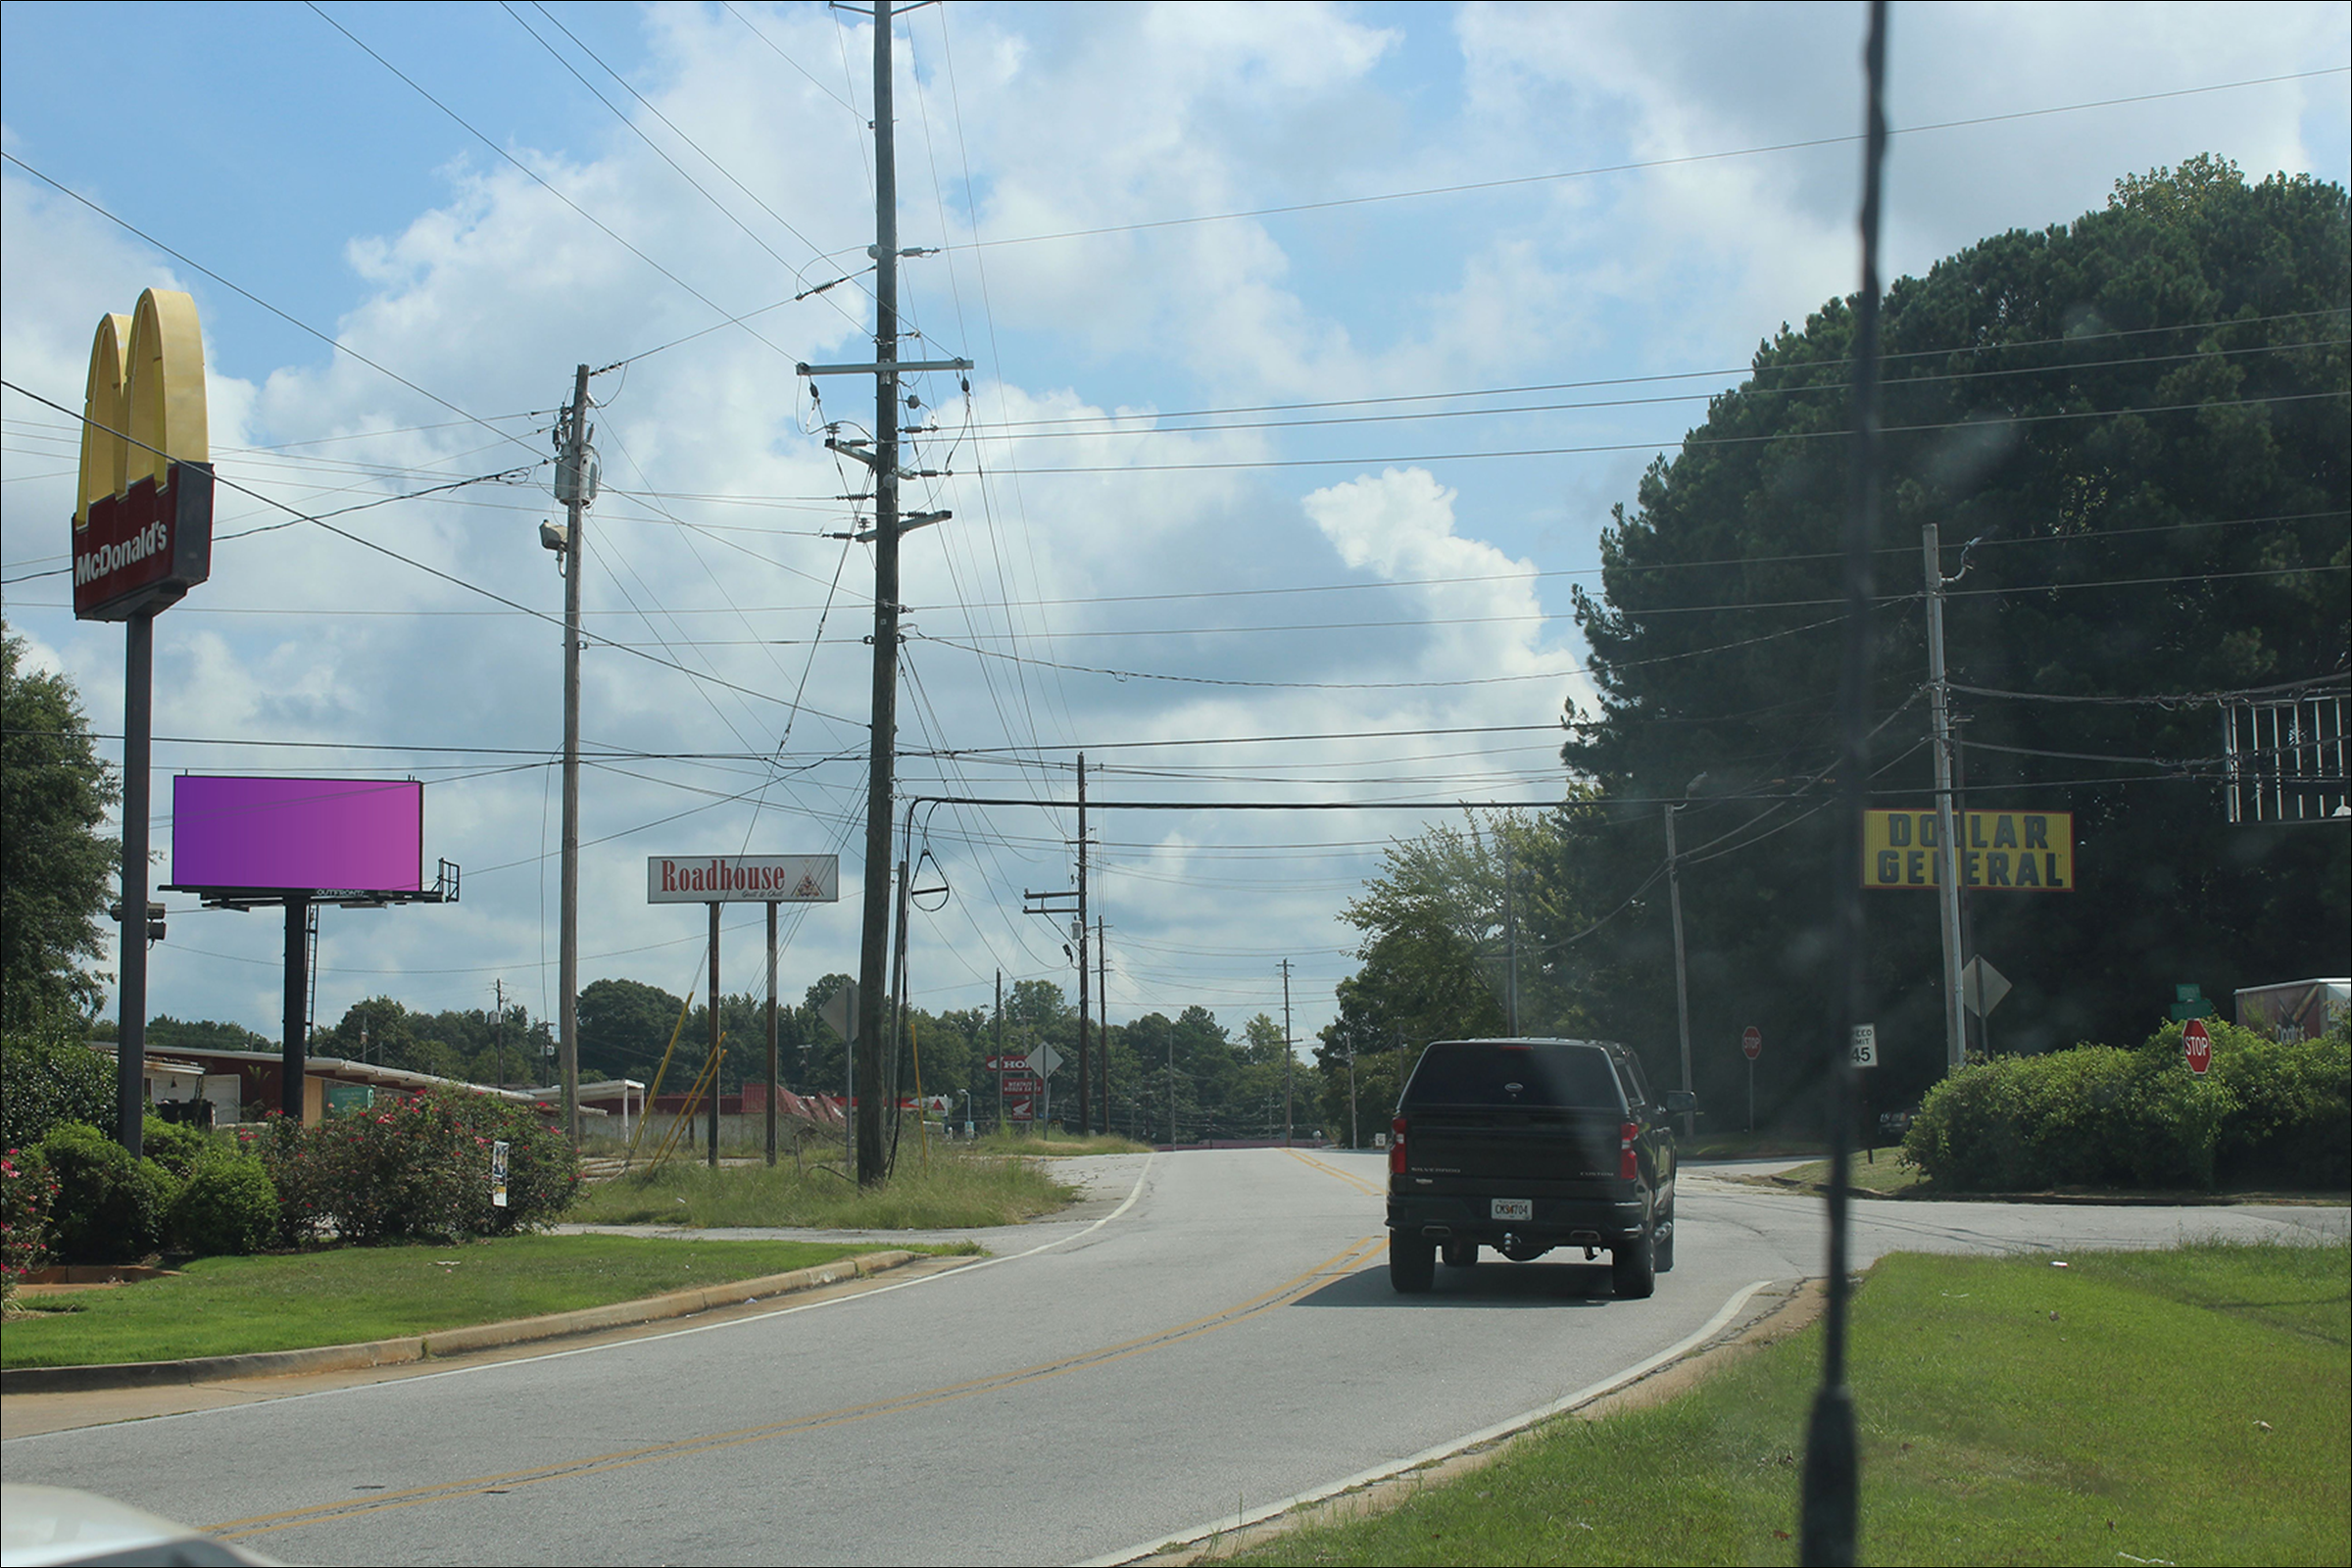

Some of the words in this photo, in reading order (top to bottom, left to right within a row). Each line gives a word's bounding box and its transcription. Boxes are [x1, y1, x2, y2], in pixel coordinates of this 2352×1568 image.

[74, 520, 168, 588] McDonald's
[661, 858, 786, 893] Roadhouse
[1744, 1037, 1761, 1049] STOP
[2184, 1036, 2208, 1055] STOP
[1851, 1047, 1871, 1062] 45
